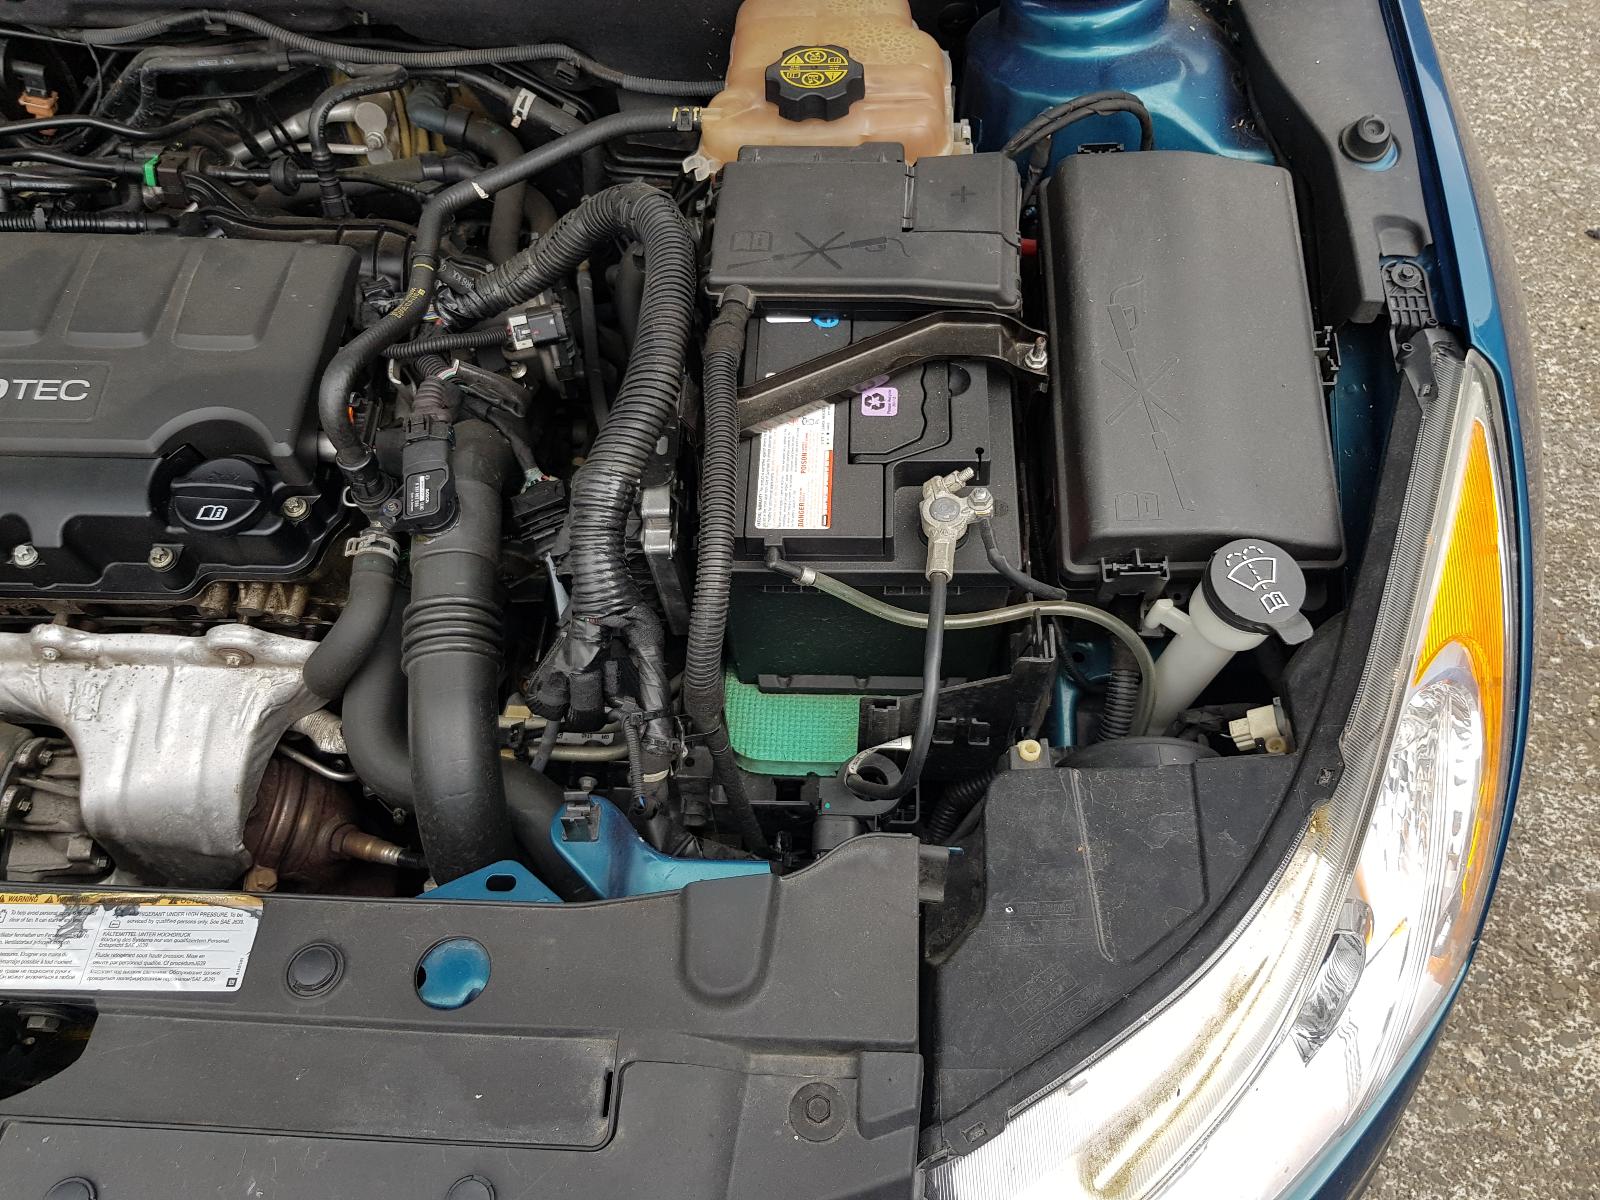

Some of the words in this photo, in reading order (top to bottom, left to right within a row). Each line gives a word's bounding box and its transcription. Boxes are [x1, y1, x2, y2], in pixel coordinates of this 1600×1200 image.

[800, 452, 808, 474] POISON
[797, 502, 805, 528] DANGER
[8, 894, 39, 903] WARNING
